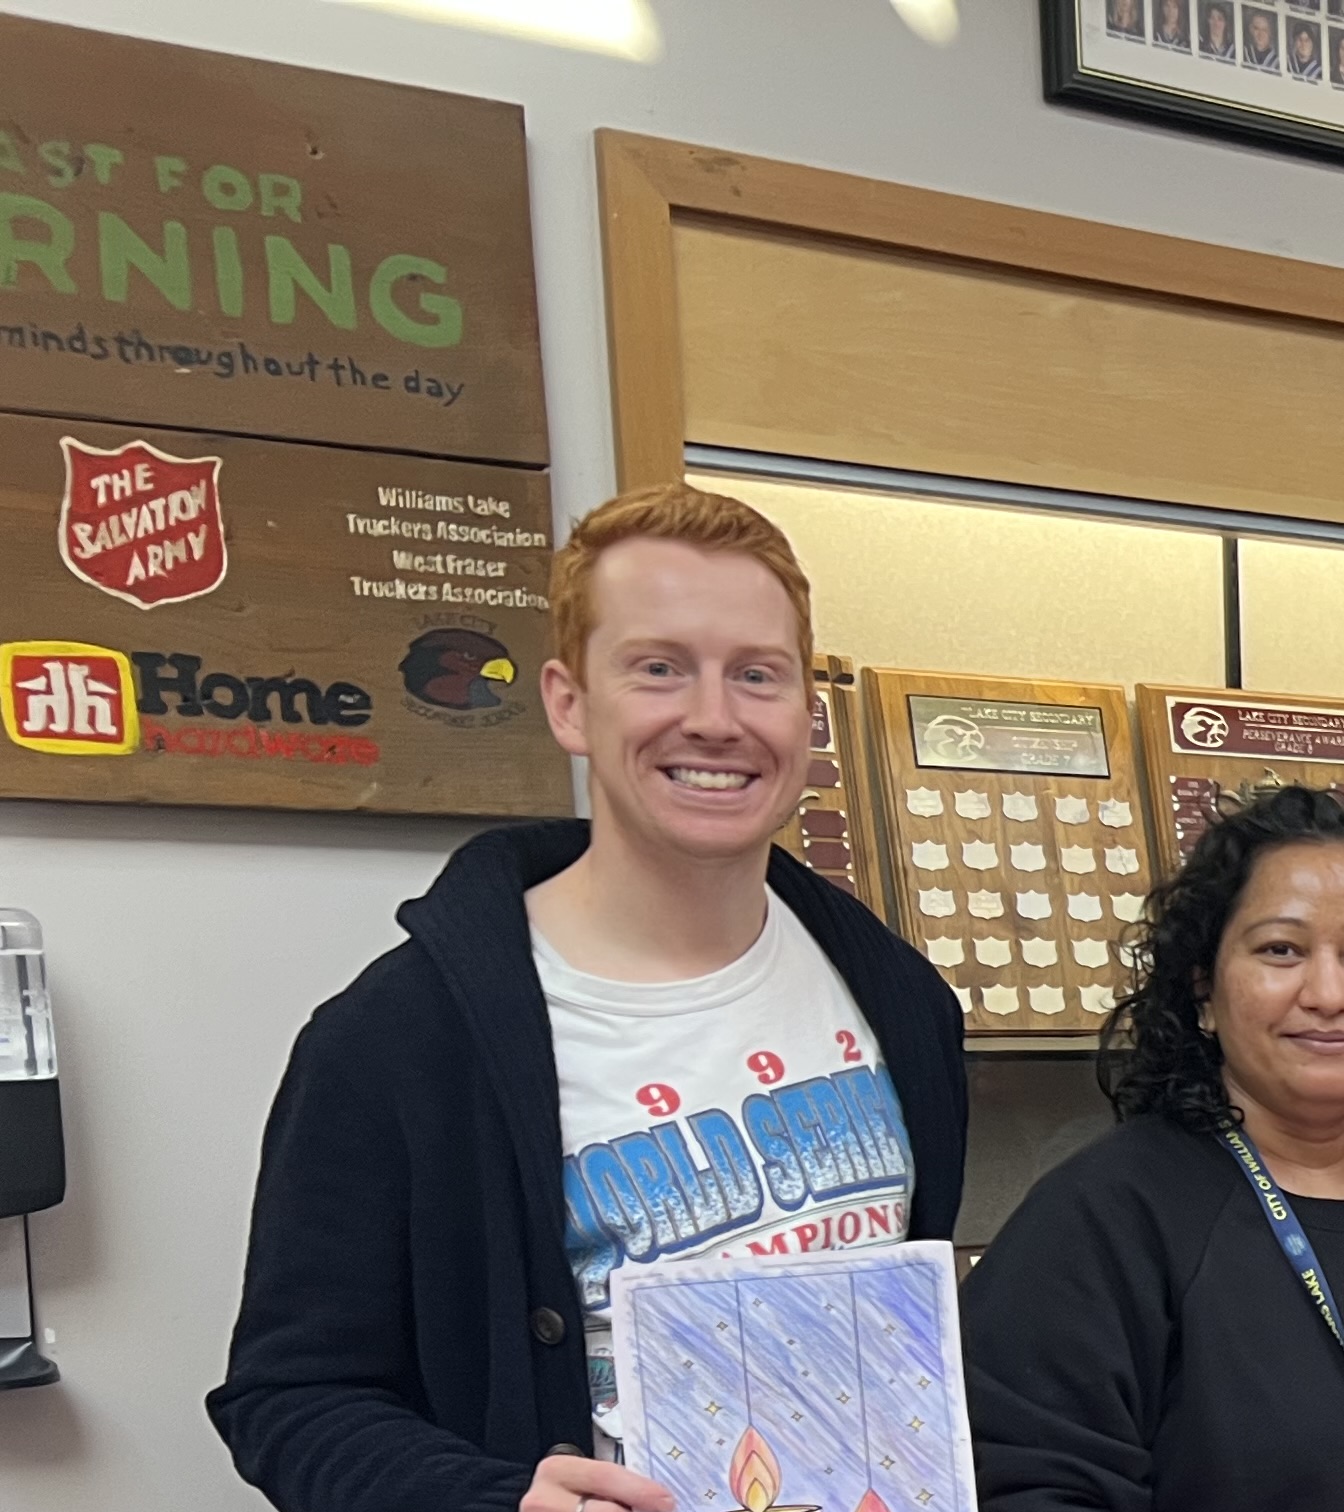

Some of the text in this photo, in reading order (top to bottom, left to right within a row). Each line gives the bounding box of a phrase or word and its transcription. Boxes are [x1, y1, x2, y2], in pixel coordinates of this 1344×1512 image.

[155, 155, 303, 223] FOR
[327, 356, 392, 390] the
[402, 369, 465, 407] day
[90, 463, 155, 508] THE
[377, 486, 511, 519] Williams Lake
[71, 479, 207, 559] SALVATION
[346, 513, 547, 548] Truckers Association
[125, 523, 207, 587] ARMY
[446, 554, 507, 578] Fraser
[441, 582, 550, 610] Association
[131, 651, 373, 727] Home
[1237, 709, 1265, 723] LAKE
[1266, 712, 1290, 725] CITY
[1242, 729, 1313, 744] PERSEVERANCE
[1253, 1173, 1272, 1191] OF
[1263, 1192, 1287, 1221] CITY
[1301, 1268, 1325, 1305] LAKE
